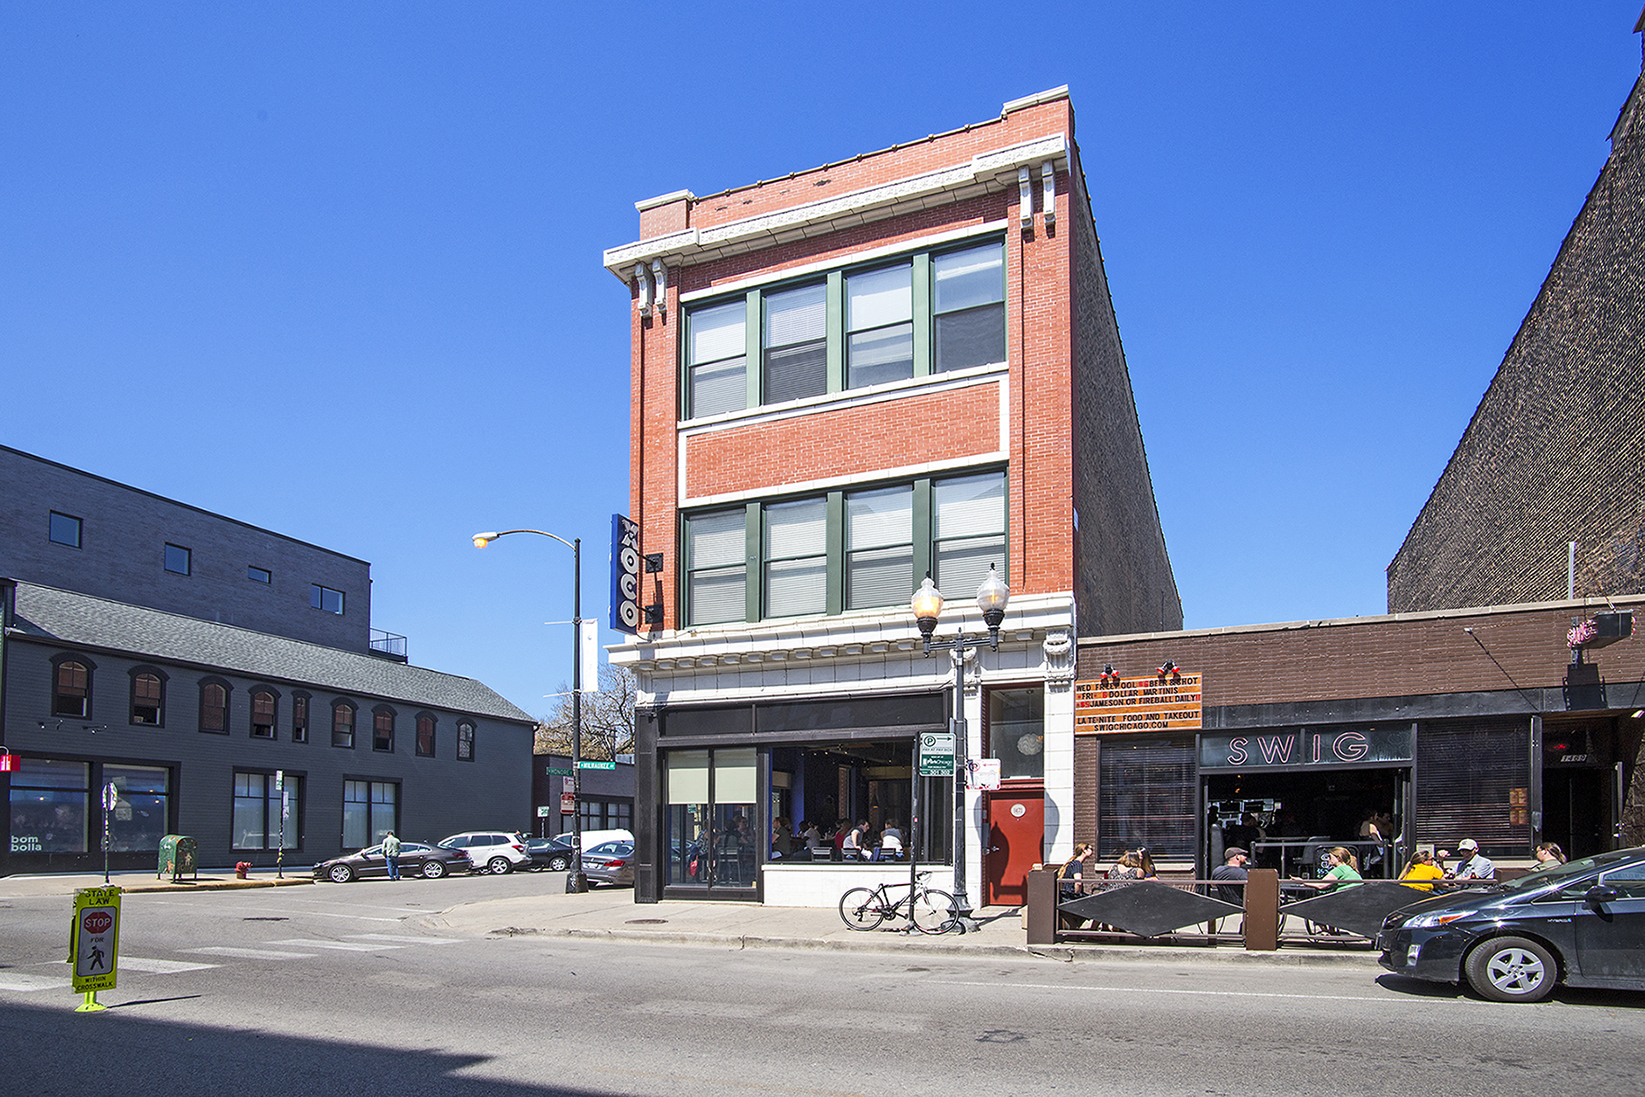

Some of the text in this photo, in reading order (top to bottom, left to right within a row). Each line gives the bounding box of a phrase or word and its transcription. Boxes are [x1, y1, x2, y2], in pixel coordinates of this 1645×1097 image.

[620, 519, 639, 628] XOCO
[1077, 684, 1091, 692] WED
[1109, 690, 1139, 698] DOLLAR
[1143, 687, 1178, 696] MARTINIS
[1139, 695, 1173, 704] FIREBALL
[1164, 711, 1199, 720] TAKEOUT
[1094, 721, 1169, 731] SWIGCHICAGO.COM
[1227, 732, 1369, 766] SWIG
[10, 835, 38, 843] bom
[10, 843, 42, 852] bolla
[85, 890, 115, 898] STATE
[89, 897, 110, 905] LAW
[85, 918, 111, 928] STOP
[77, 980, 113, 991] CROSSWALK
